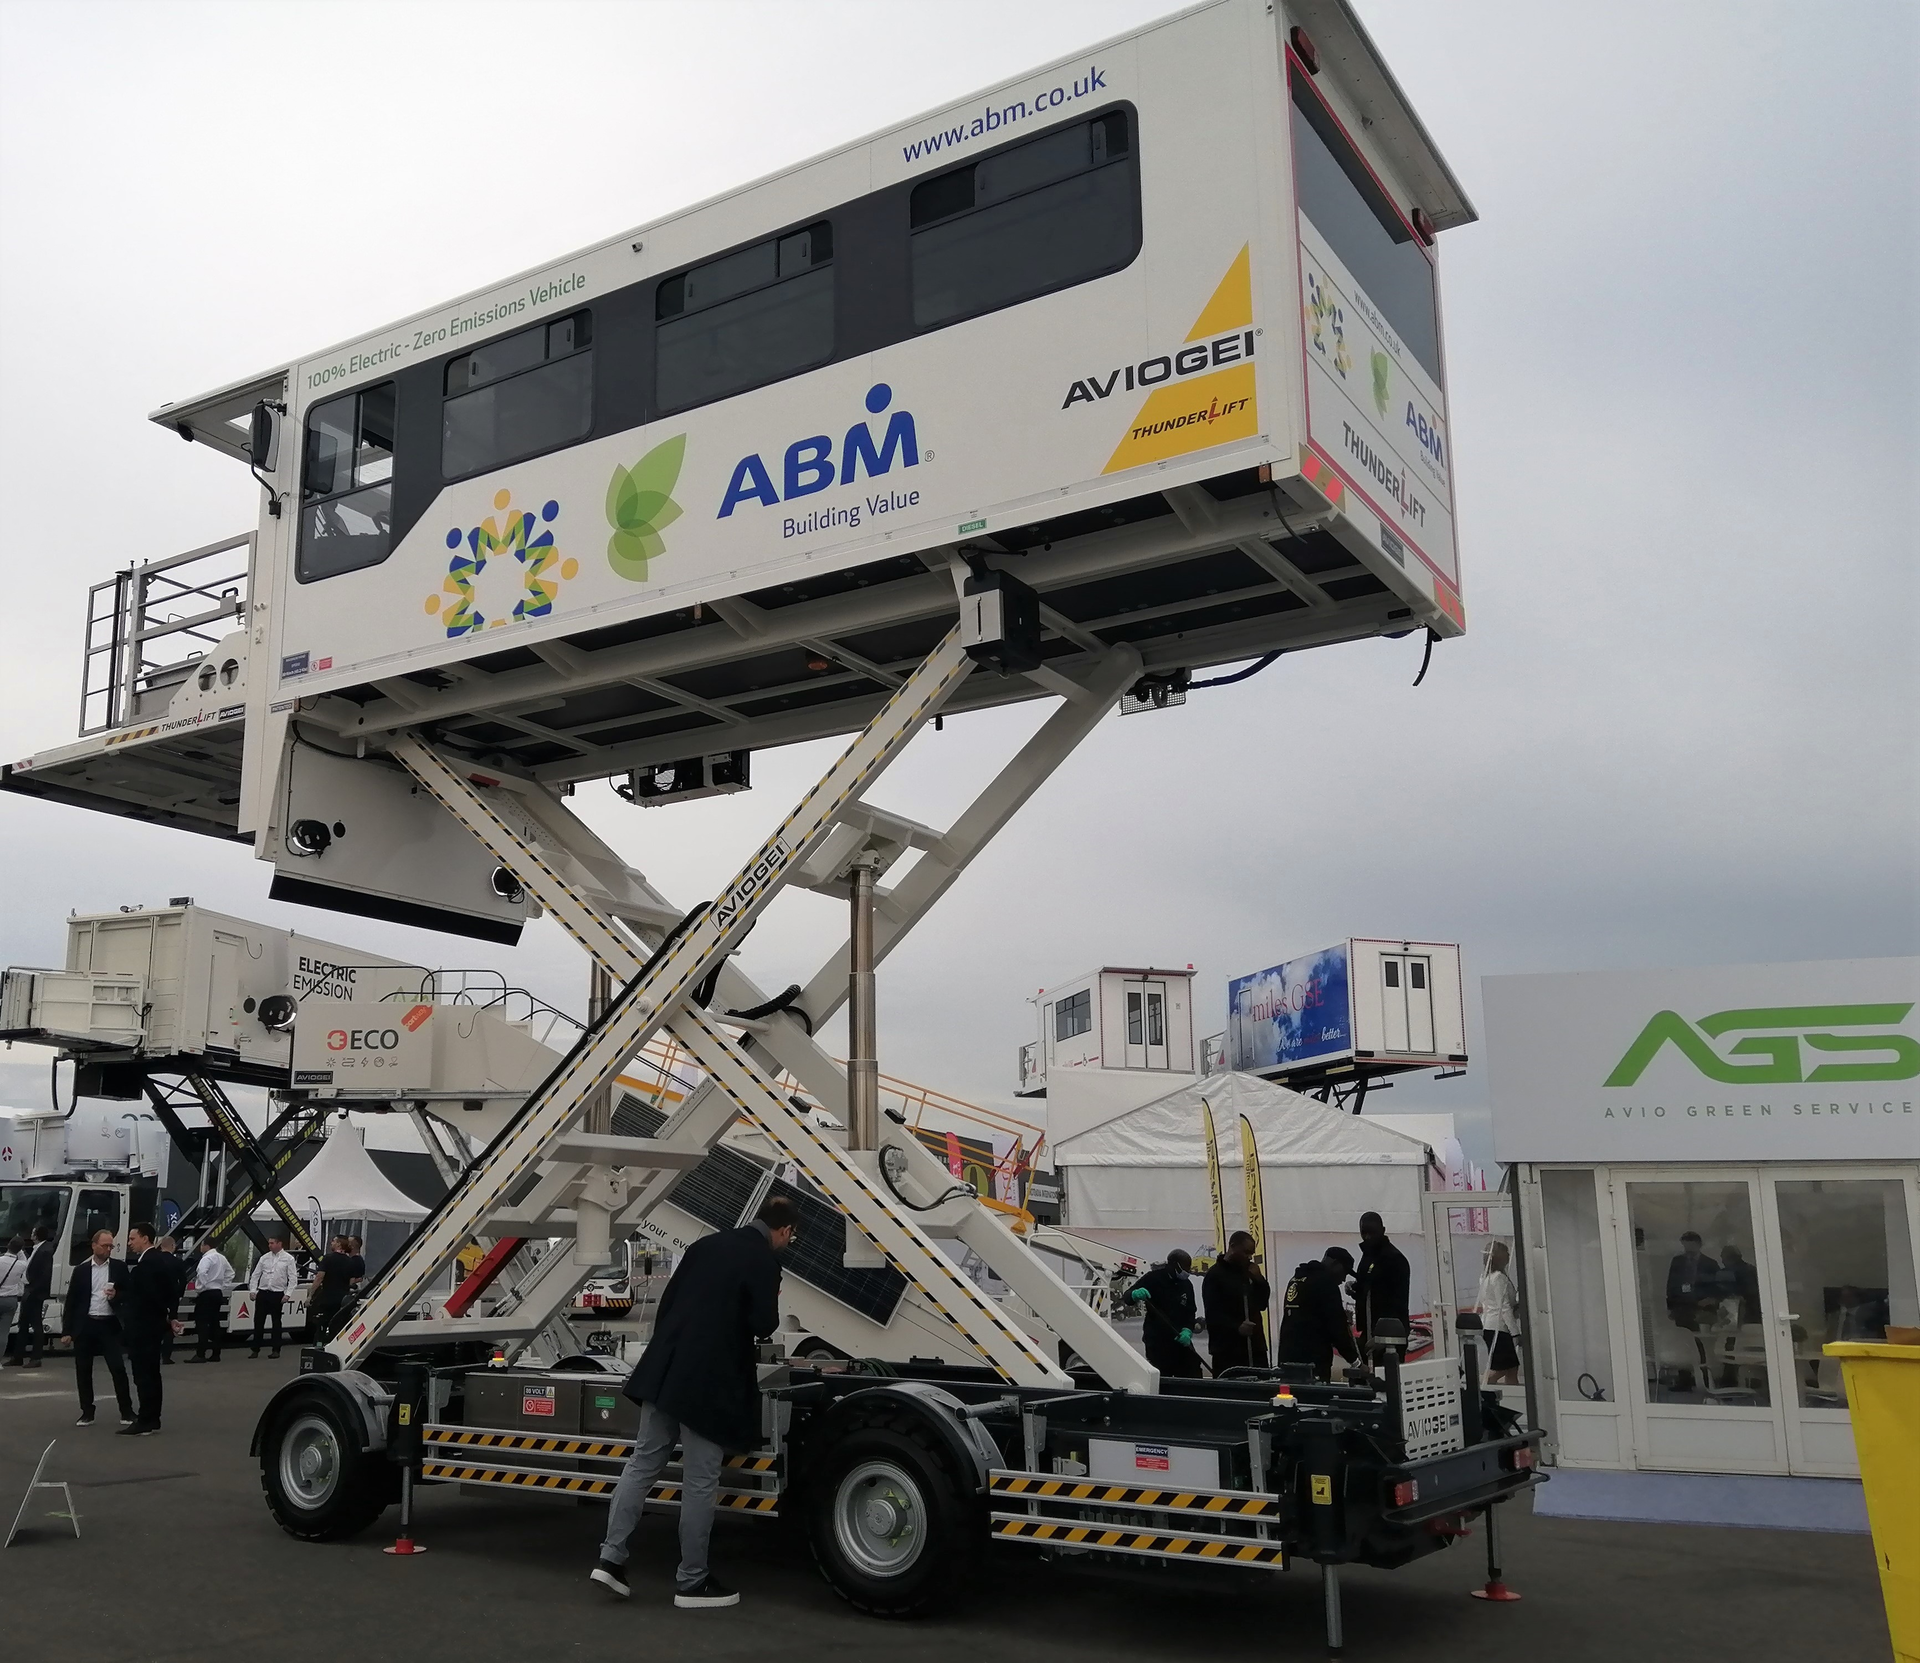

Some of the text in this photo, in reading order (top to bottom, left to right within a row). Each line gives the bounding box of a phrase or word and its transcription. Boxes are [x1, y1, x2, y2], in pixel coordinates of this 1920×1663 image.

[902, 65, 1107, 163] www.abm.co.uk
[307, 362, 346, 389] 100%
[349, 342, 401, 374] Electric
[412, 328, 447, 352] Zero
[449, 296, 526, 337] Emissions
[528, 272, 586, 307] Vehicle
[1061, 330, 1255, 410] AVIOGEI
[1132, 397, 1249, 440] THUNDERLIFT
[1405, 401, 1445, 467] ABM
[716, 384, 919, 519] ABM
[1343, 420, 1426, 529] THUNDERLIFT
[783, 489, 920, 539] Building Value
[961, 521, 984, 532] DIESEL
[161, 711, 217, 732] THUNDERLIFT
[717, 844, 785, 928] AVIOGEI
[293, 974, 353, 1002] EMISSION
[299, 956, 358, 984] ELECTRIC
[1291, 978, 1324, 1012] GSE
[1601, 1002, 1920, 1088] AGS
[1604, 1106, 1666, 1119] AVIO
[1686, 1104, 1772, 1118] GREEN
[640, 1220, 668, 1239] your
